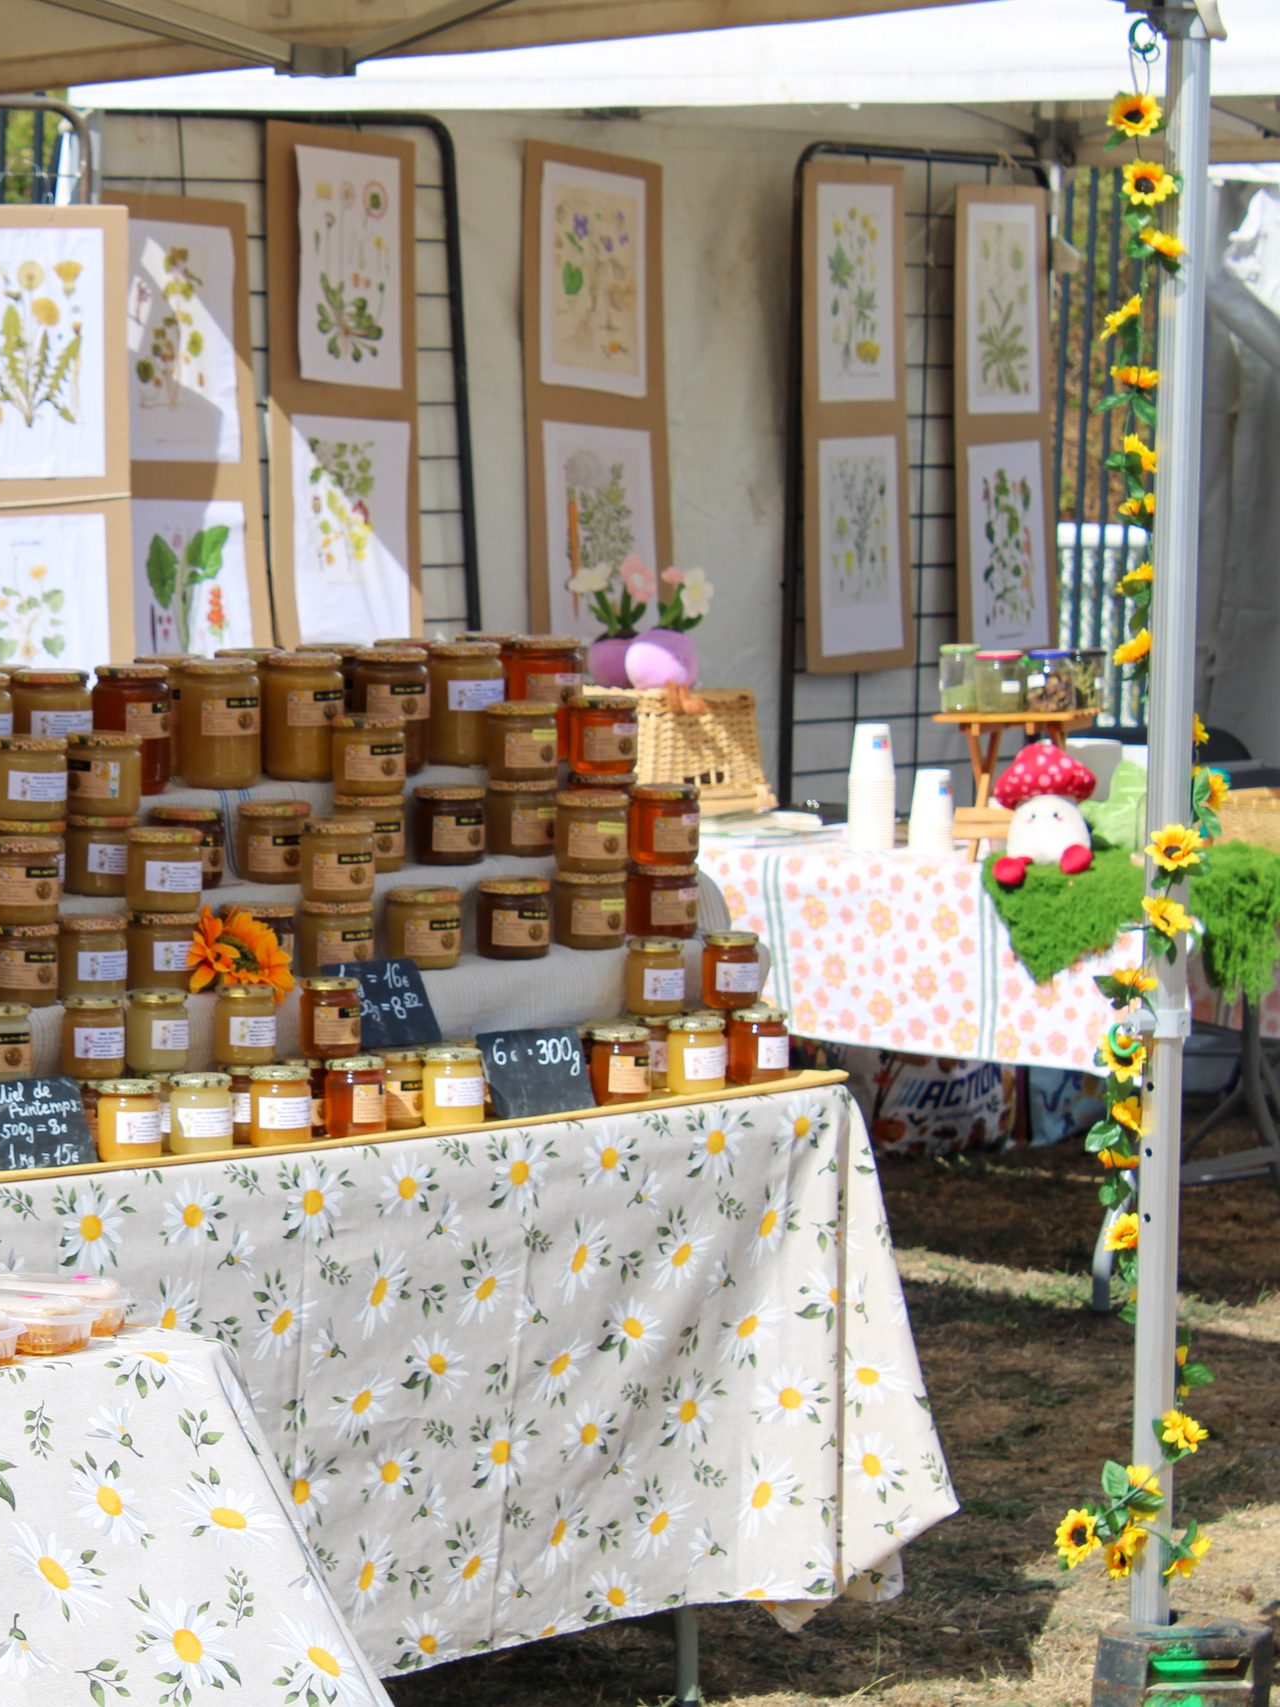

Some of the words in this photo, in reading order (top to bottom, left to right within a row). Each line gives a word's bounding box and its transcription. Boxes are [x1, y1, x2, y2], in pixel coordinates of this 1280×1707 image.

[535, 1036, 581, 1077] 300g
[32, 1081, 53, 1099] de
[917, 1062, 1003, 1110] ACTION
[0, 1121, 35, 1144] 500g
[47, 1118, 68, 1136] 8€
[53, 1143, 80, 1166] 15€
